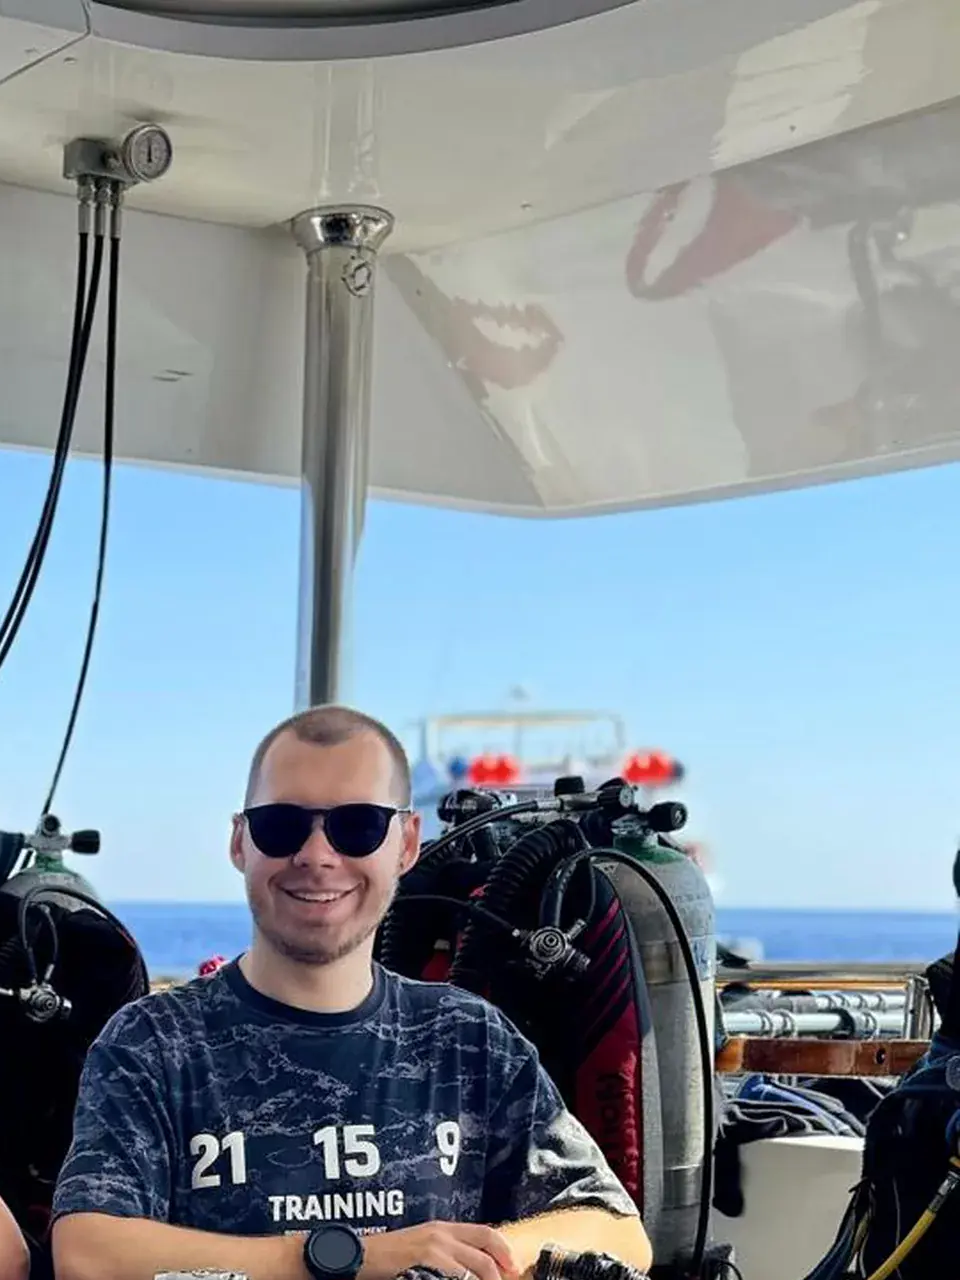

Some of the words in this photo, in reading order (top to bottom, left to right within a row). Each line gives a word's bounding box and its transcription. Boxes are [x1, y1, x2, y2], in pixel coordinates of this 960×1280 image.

[191, 1131, 246, 1190] 21
[314, 1124, 381, 1180] 15
[436, 1121, 460, 1176] 9
[268, 1189, 404, 1222] TRAINING
